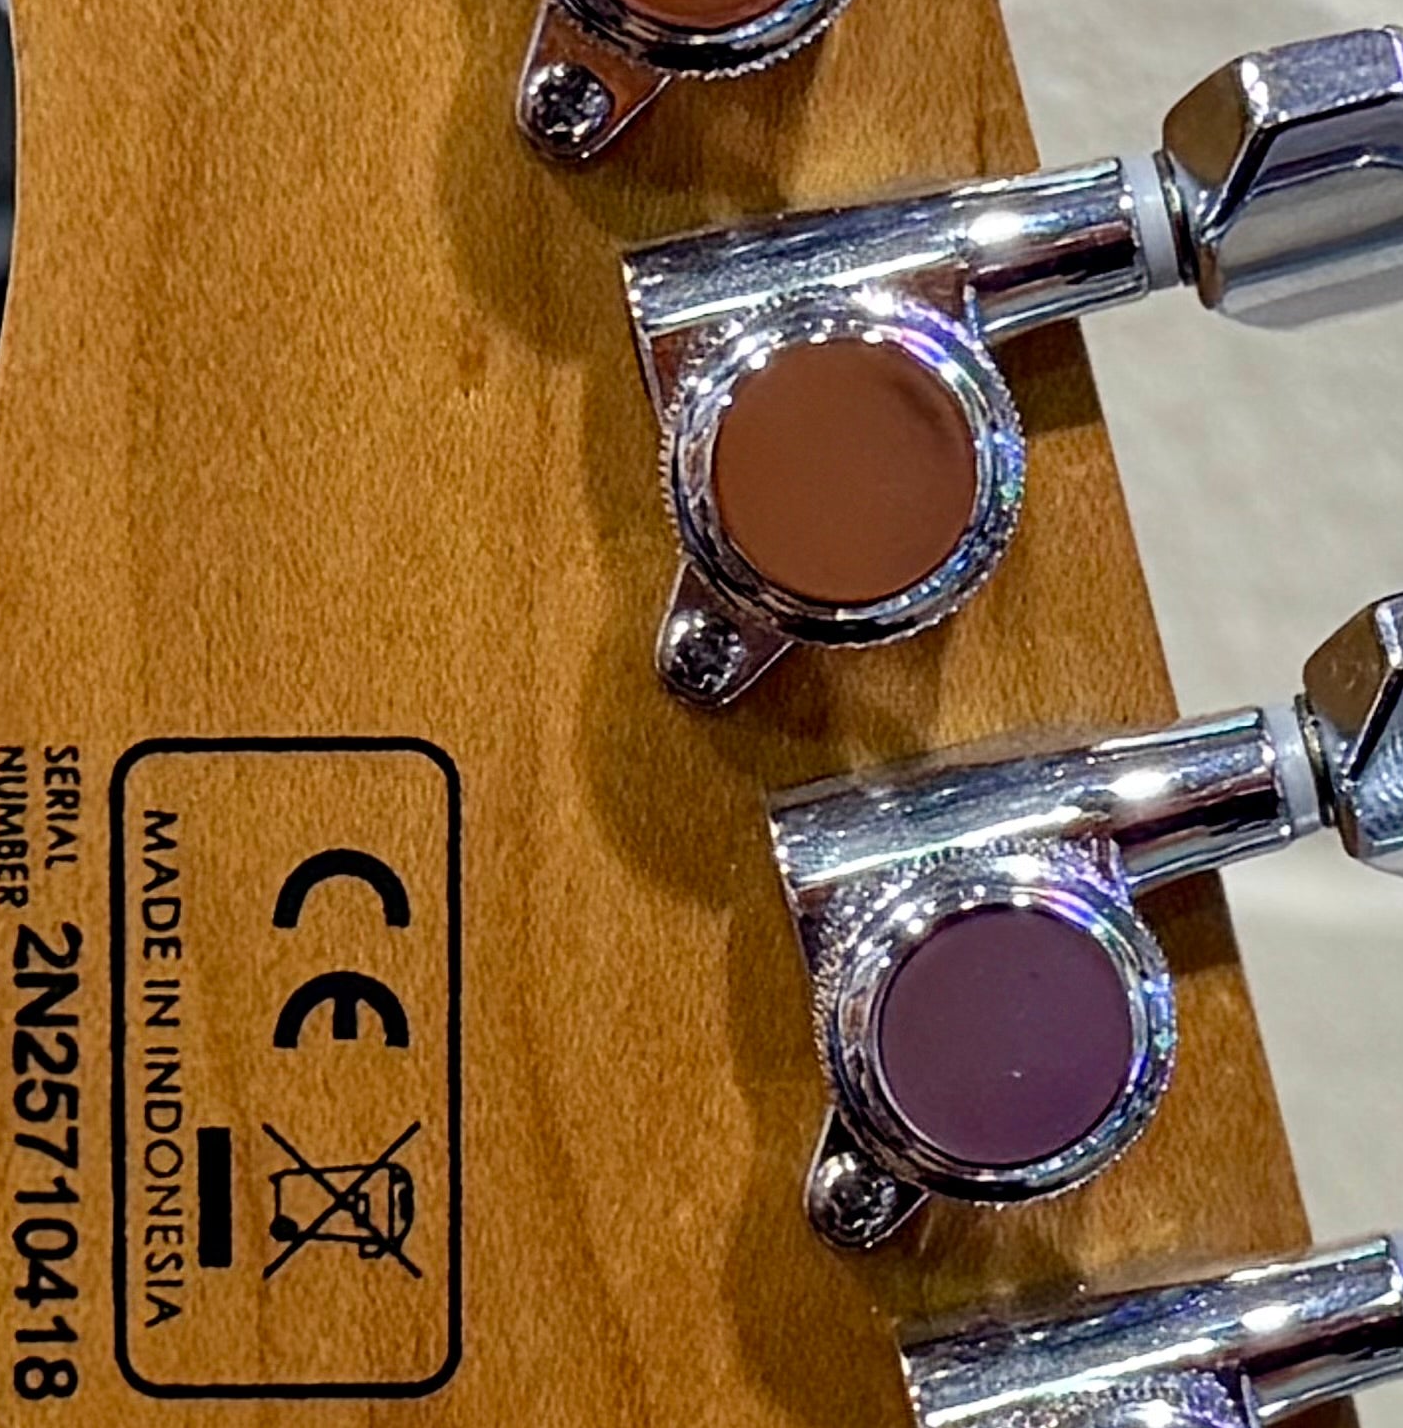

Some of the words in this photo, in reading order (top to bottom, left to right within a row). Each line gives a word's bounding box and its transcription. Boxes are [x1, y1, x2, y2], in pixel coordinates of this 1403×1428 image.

[44, 745, 79, 869] SERIAL
[143, 809, 183, 961] MADE
[143, 979, 180, 1027] IN
[272, 848, 410, 1049] CE
[12, 922, 83, 1401] 2N25710418
[143, 1047, 183, 1329] INDONESIA
